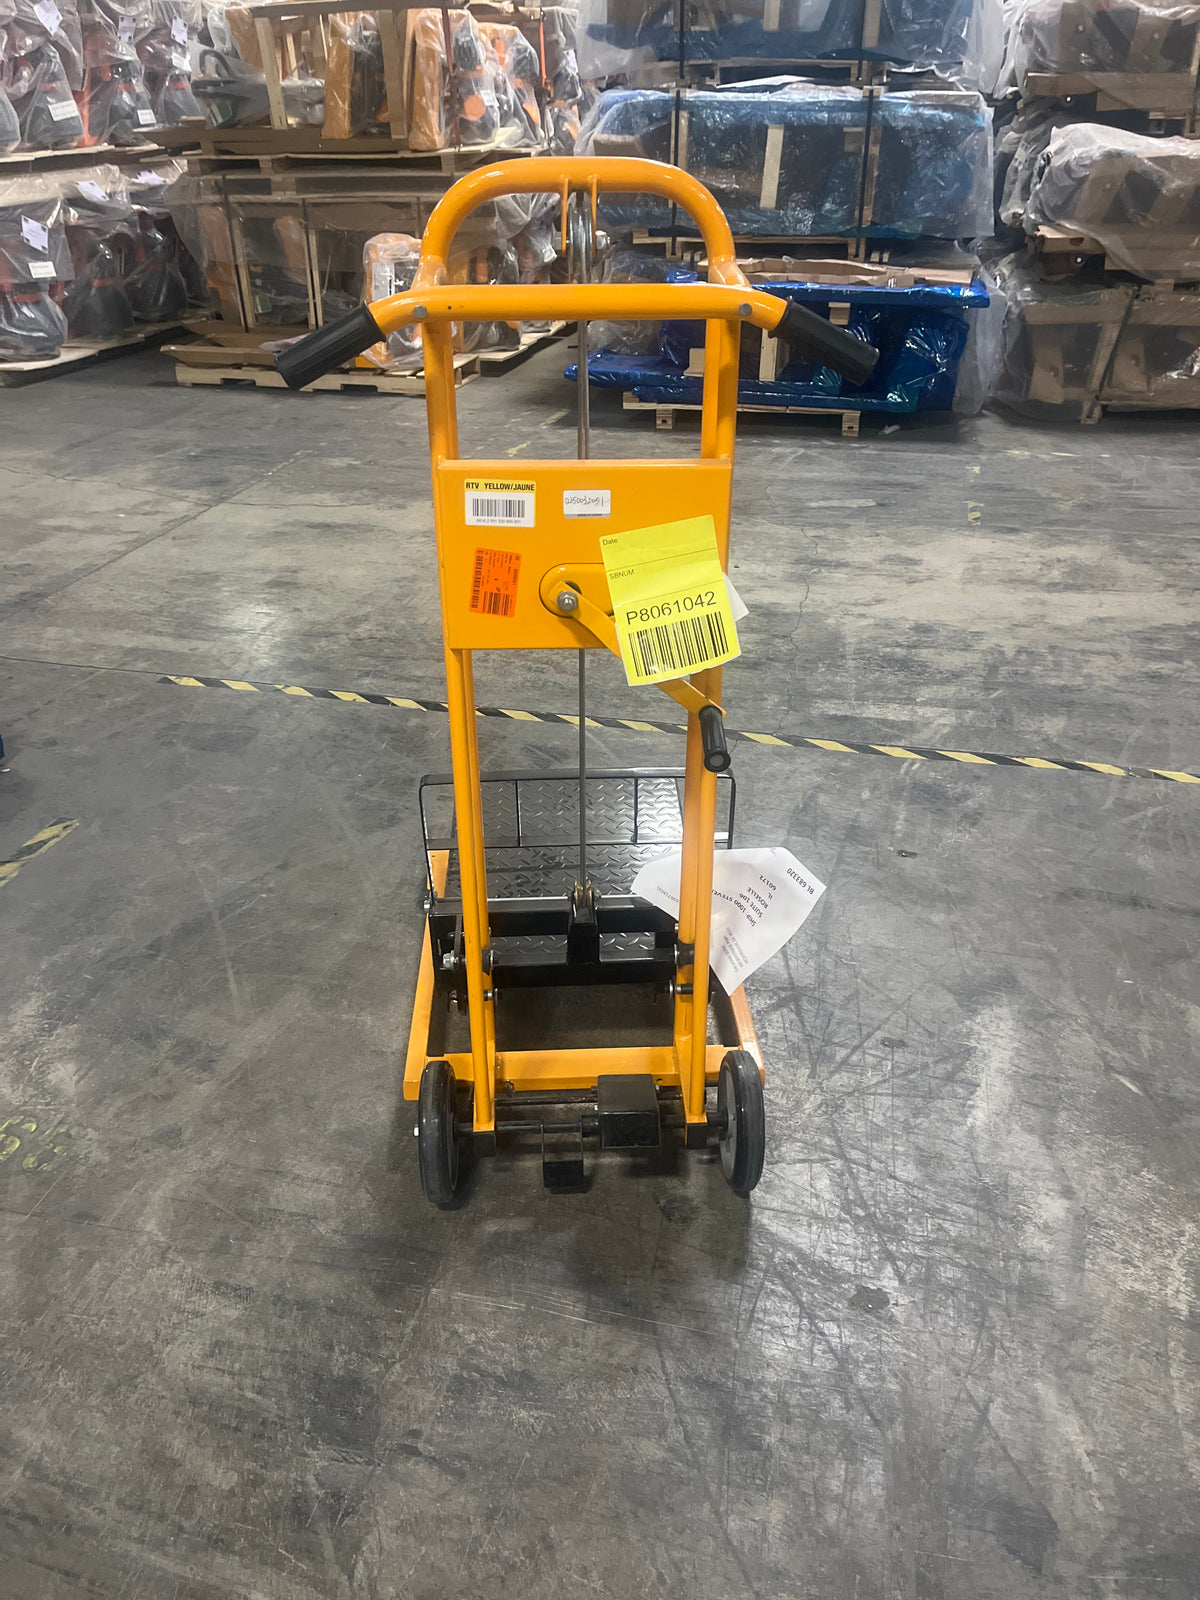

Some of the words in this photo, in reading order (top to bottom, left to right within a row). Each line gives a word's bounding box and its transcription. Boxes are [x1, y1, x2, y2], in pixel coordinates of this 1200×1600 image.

[484, 482, 535, 491] YELLOW/JAUNE
[609, 569, 635, 580] SBNUM
[626, 591, 717, 625] P8061042
[759, 875, 777, 891] 60172
[786, 867, 807, 888] 683320
[747, 886, 769, 909] ROSELLE
[807, 885, 815, 895] BL
[750, 901, 763, 918] SUITE
